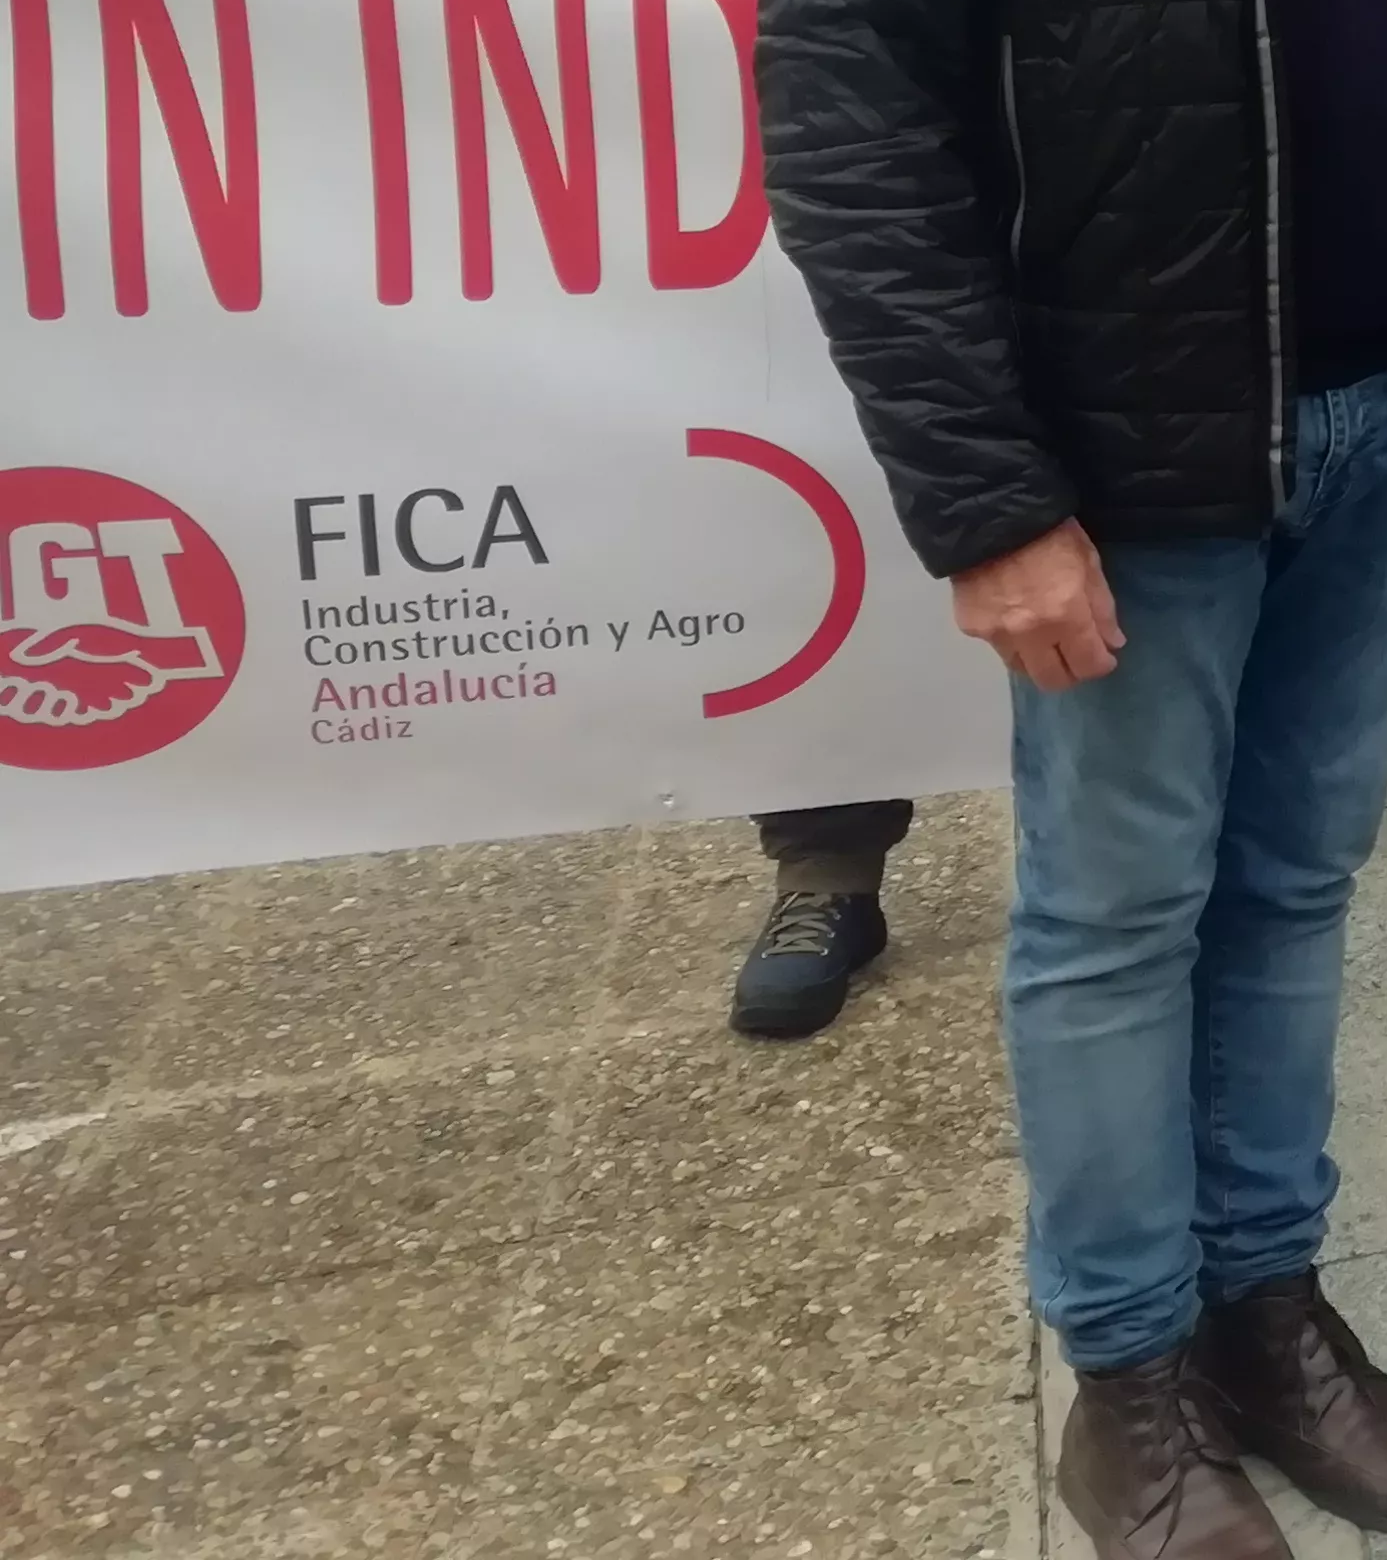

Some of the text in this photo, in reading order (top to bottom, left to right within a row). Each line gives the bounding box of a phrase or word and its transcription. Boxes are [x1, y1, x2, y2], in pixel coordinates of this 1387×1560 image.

[293, 484, 549, 581] FICA
[0, 518, 186, 630] GT
[301, 586, 512, 630] Industria,
[303, 604, 747, 669] Construcción y Agro
[311, 666, 558, 715] Andalucía
[311, 714, 415, 747] Cádiz
